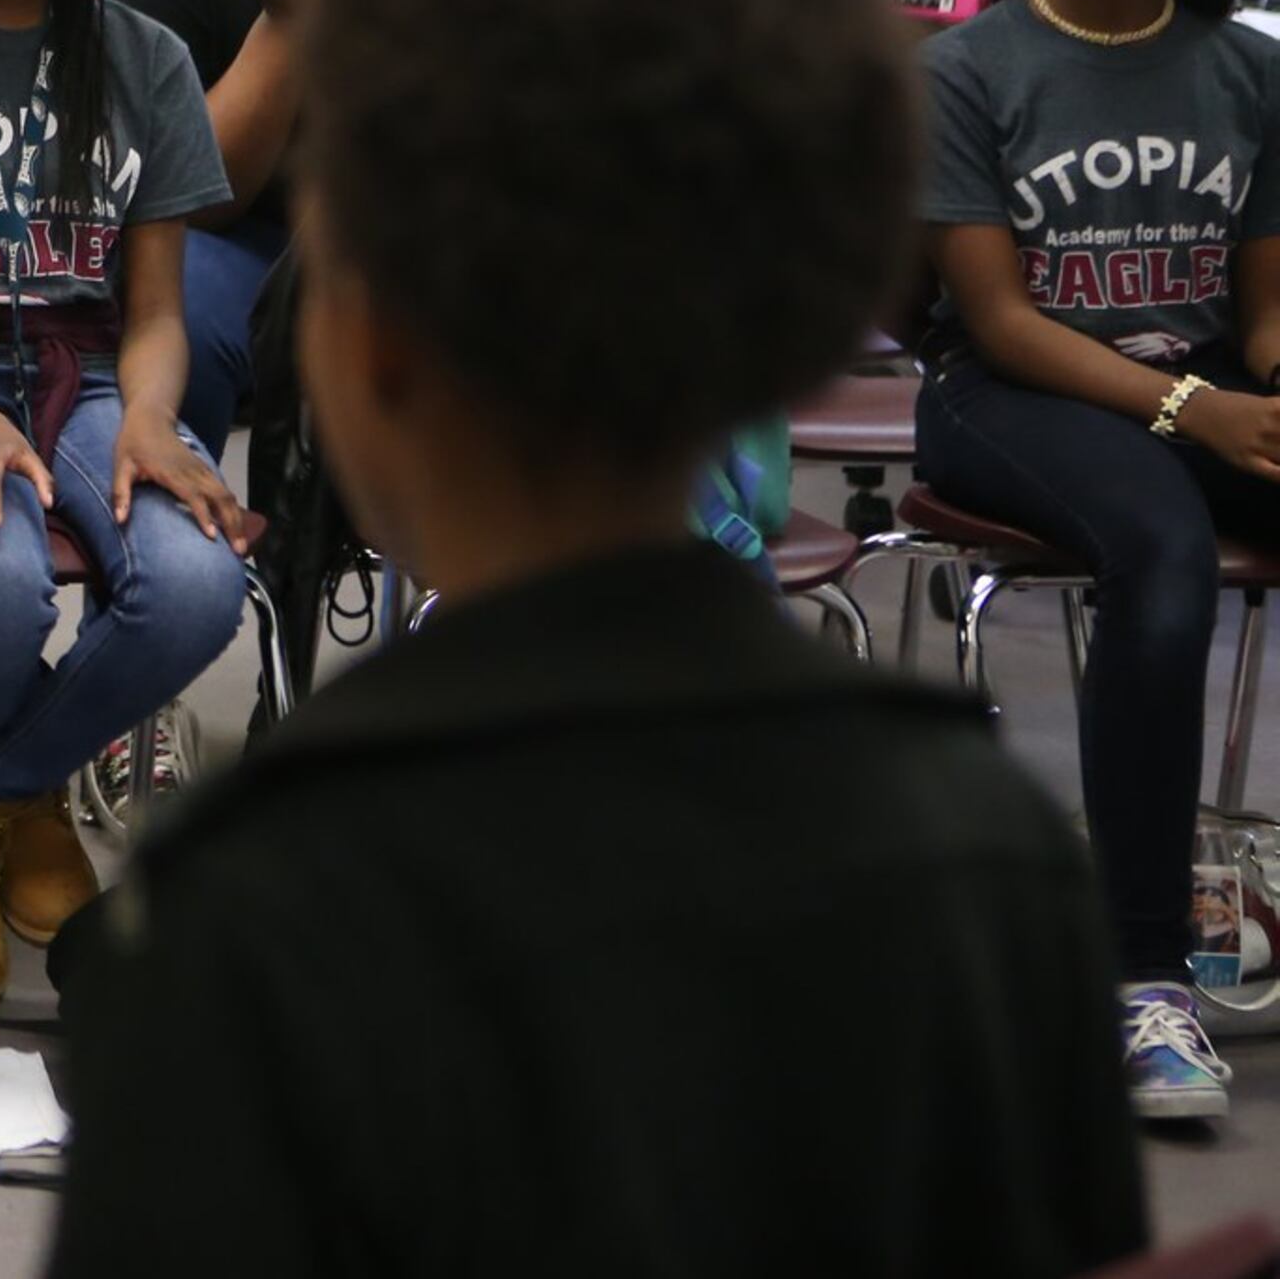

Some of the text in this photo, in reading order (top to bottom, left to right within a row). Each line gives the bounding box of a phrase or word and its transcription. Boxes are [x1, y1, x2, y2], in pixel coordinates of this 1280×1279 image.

[1009, 135, 1252, 231] UTOPIA
[1045, 226, 1131, 247] Academy
[1135, 222, 1164, 242] for
[1170, 222, 1197, 243] the
[1020, 244, 1228, 310] EAGLE
